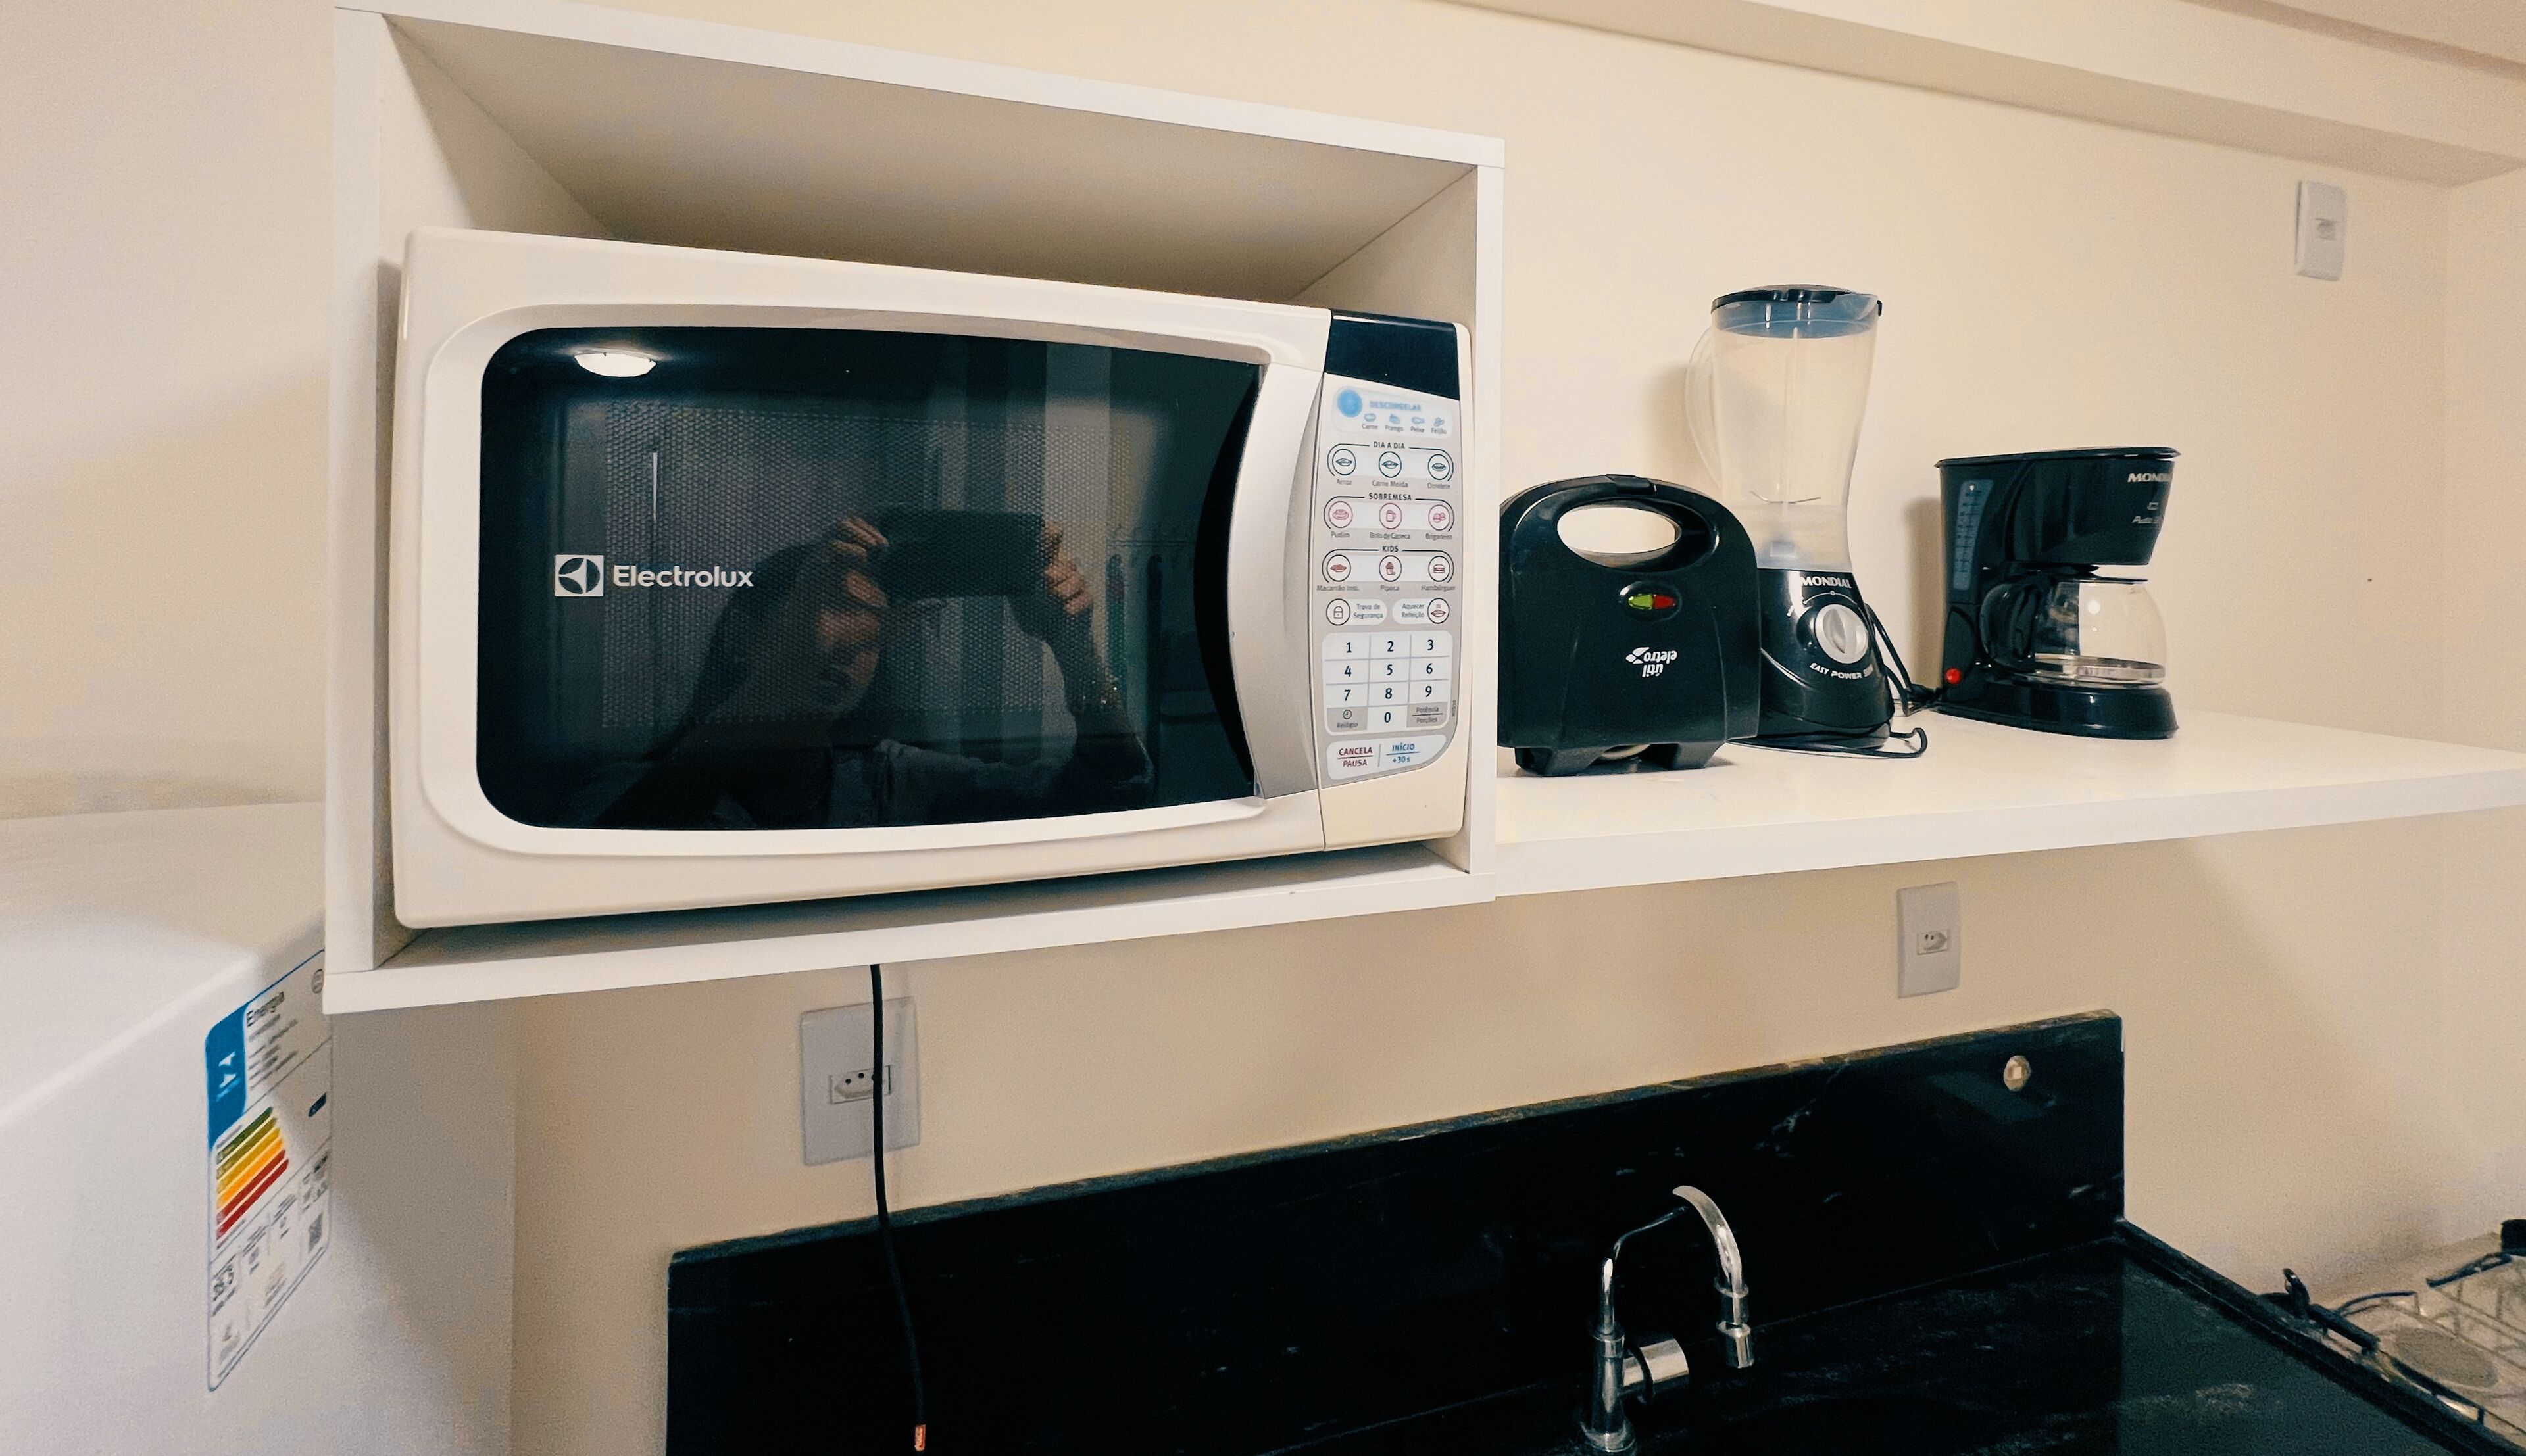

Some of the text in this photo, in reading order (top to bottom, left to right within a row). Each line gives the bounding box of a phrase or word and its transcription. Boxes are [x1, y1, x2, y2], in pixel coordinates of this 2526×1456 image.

[613, 565, 754, 587] Electrolux
[1800, 576, 1852, 589] MONDIAL
[1347, 642, 1352, 653] 1
[1387, 641, 1394, 652] 2
[1427, 639, 1434, 650] 3
[1643, 650, 1677, 664] eletro
[1344, 666, 1352, 677] 4
[1387, 664, 1393, 675] 5
[1426, 663, 1433, 674] 6
[1642, 664, 1664, 677] útil
[1810, 662, 1829, 675] EASY
[1831, 670, 1862, 679] POWER
[1344, 689, 1351, 701] 7
[1385, 688, 1393, 699] 8
[1425, 686, 1432, 697] 9
[1384, 712, 1391, 723] 0
[1339, 747, 1372, 756] CANCELA
[1392, 742, 1415, 752] INÍCIO
